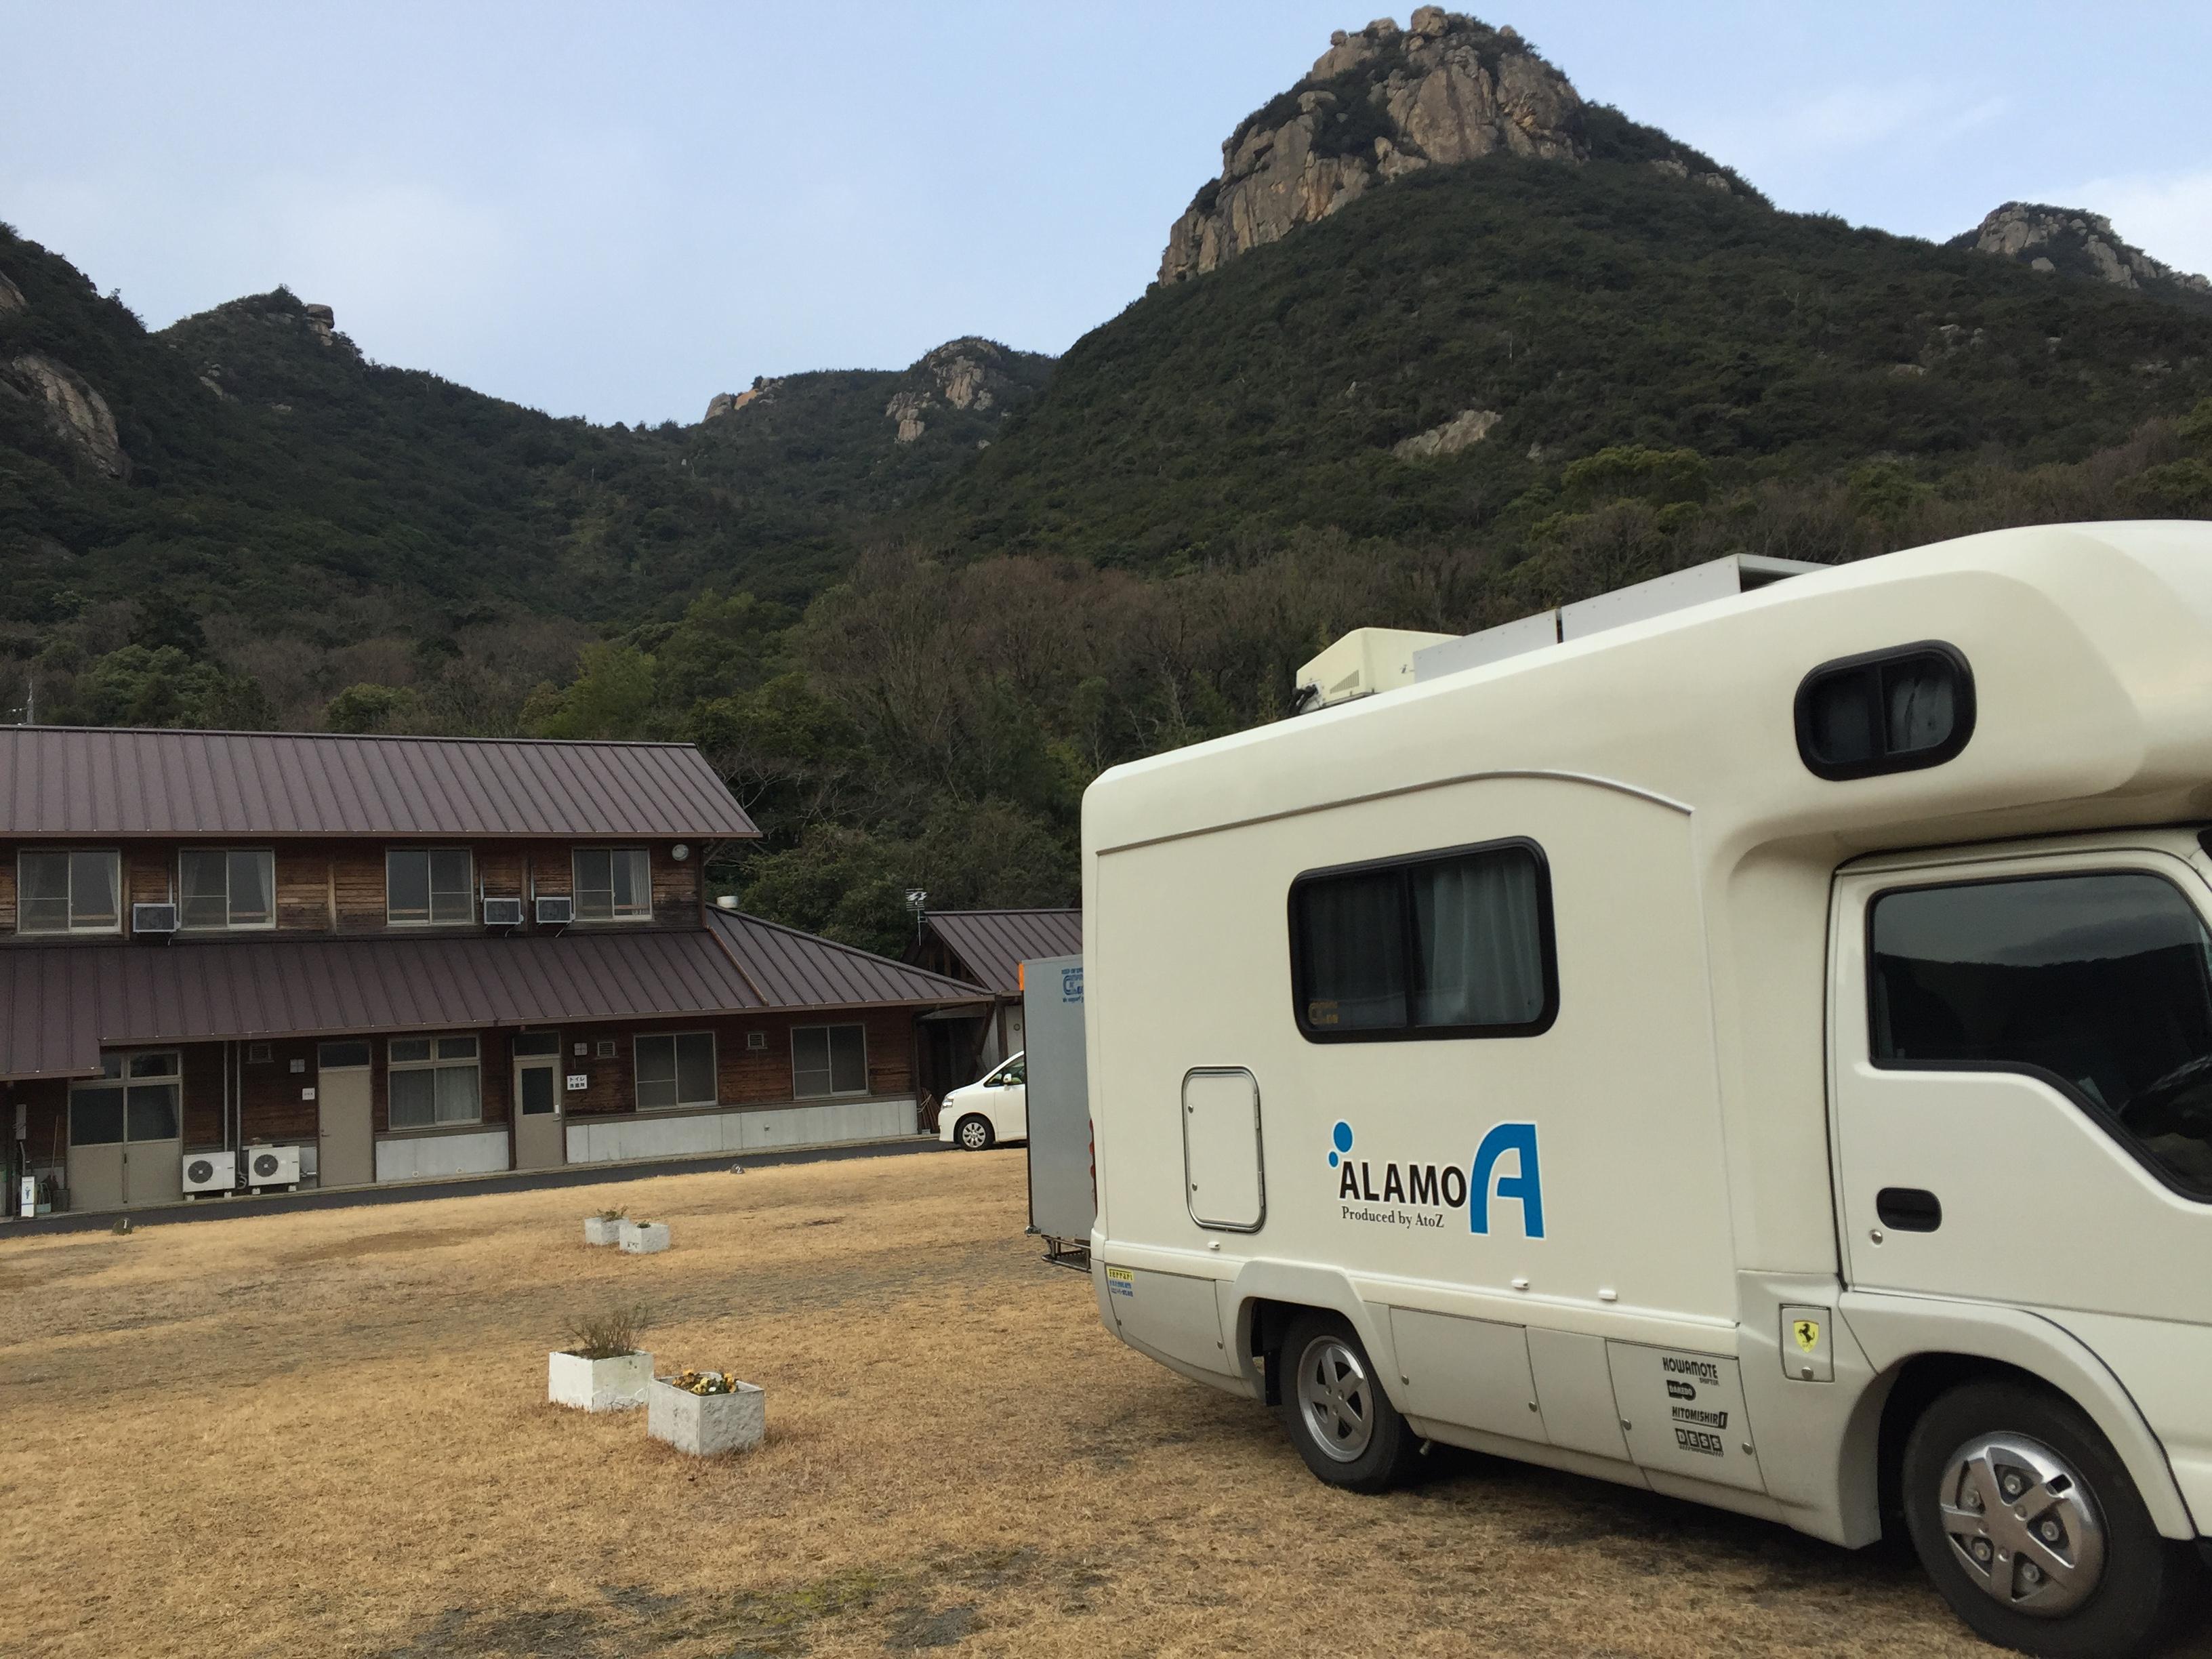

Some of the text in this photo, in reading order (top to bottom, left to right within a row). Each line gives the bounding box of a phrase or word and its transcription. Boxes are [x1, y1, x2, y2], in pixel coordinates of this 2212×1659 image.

[1339, 1160, 1467, 1208] ALAMO
[1342, 1206, 1445, 1229] Produced by AtoZ
